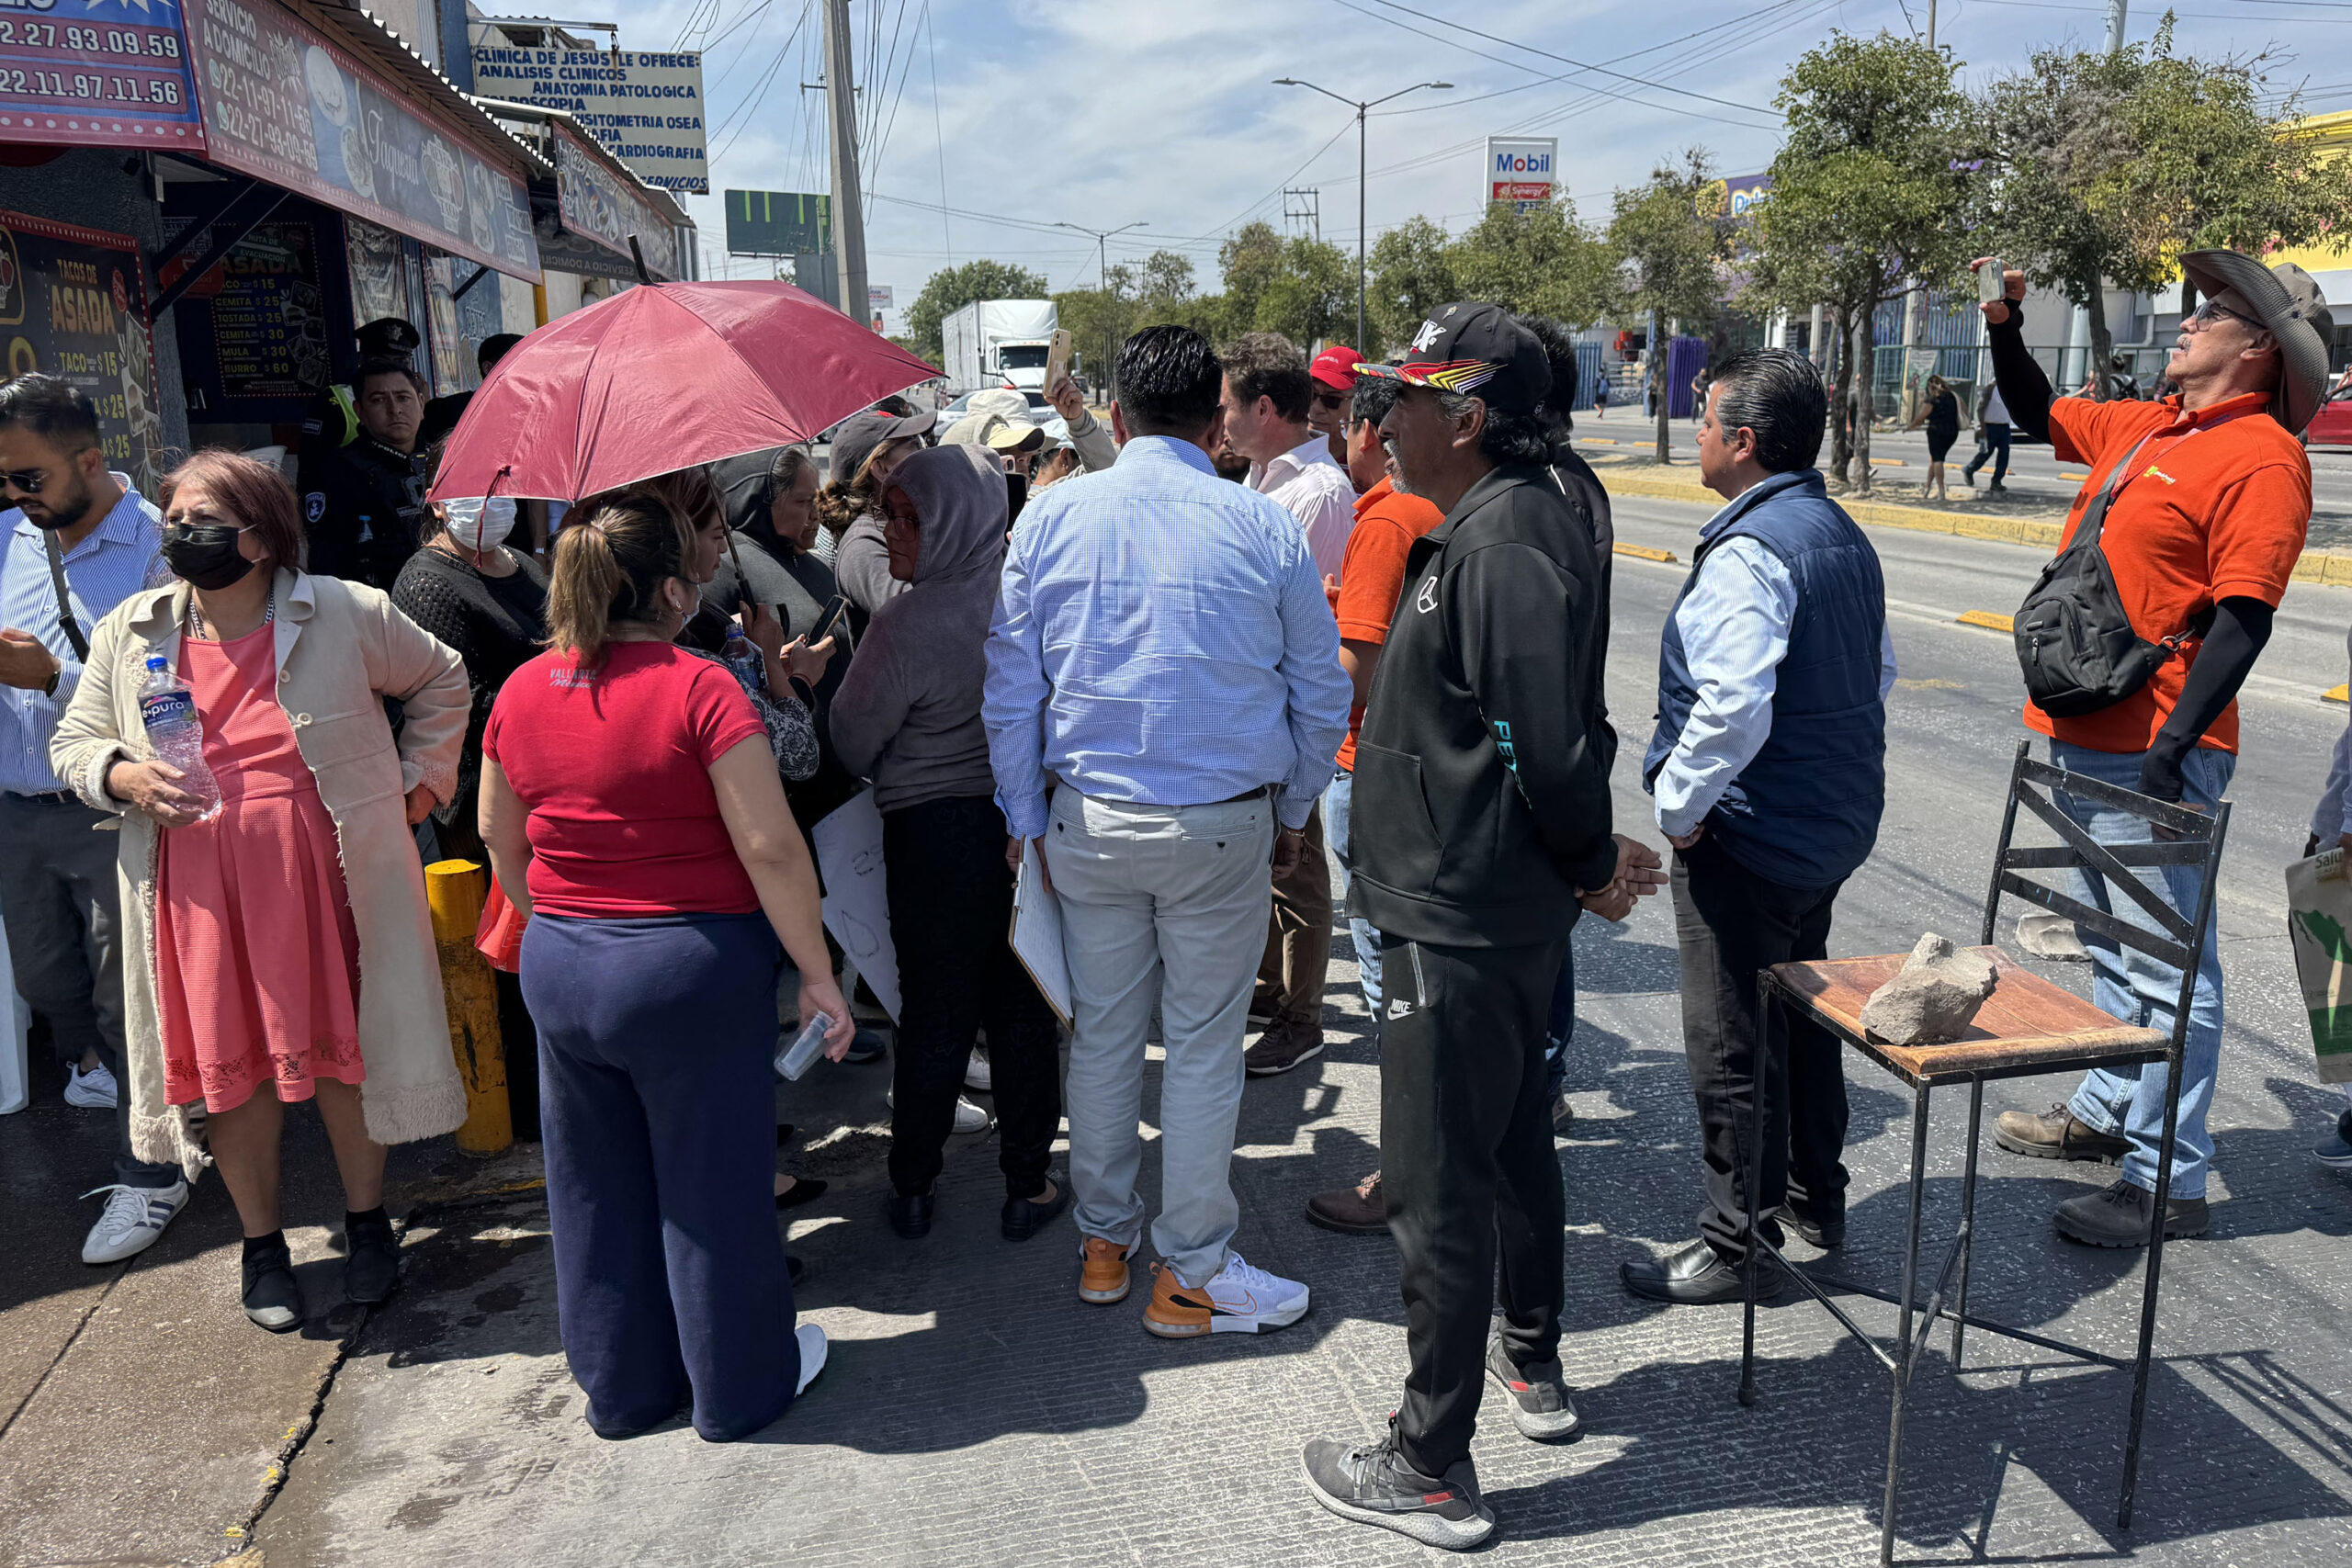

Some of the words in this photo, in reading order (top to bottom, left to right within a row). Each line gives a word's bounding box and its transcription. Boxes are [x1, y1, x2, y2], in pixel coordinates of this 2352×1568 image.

[206, 0, 257, 41] SERVICIO
[203, 17, 214, 50] A
[212, 23, 270, 81] DOMICILIO
[476, 49, 533, 64] CLINICA
[537, 51, 557, 65] DE
[561, 52, 610, 66] JESUS
[619, 53, 633, 67] LE
[639, 54, 700, 68] OFRECE:
[479, 65, 553, 79] ANALISIS
[559, 67, 627, 82] CLINICOS
[533, 82, 606, 96] ANATOMIA
[609, 85, 696, 98] PATOLOGICA
[575, 114, 663, 128] NSITOMETRIA
[666, 117, 702, 130] OSEA
[1497, 153, 1550, 173] Mobil
[57, 258, 87, 282] TACOS
[87, 264, 98, 286] DE
[51, 285, 117, 335] ASADA
[215, 297, 252, 308] CEMITA
[264, 296, 280, 308] 25
[218, 313, 256, 323] TOSTADA
[220, 330, 251, 340] CEMITA
[268, 329, 285, 340] 30
[221, 347, 250, 357] MULA
[270, 345, 287, 357] 30
[59, 352, 87, 374] TACO
[104, 352, 119, 377] 15
[224, 364, 257, 374] BURRO
[110, 394, 126, 419] 25
[116, 434, 130, 459] 25
[550, 668, 596, 681] VALLARTA
[2315, 851, 2344, 870] Salu
[1391, 998, 1412, 1014] NIKE
